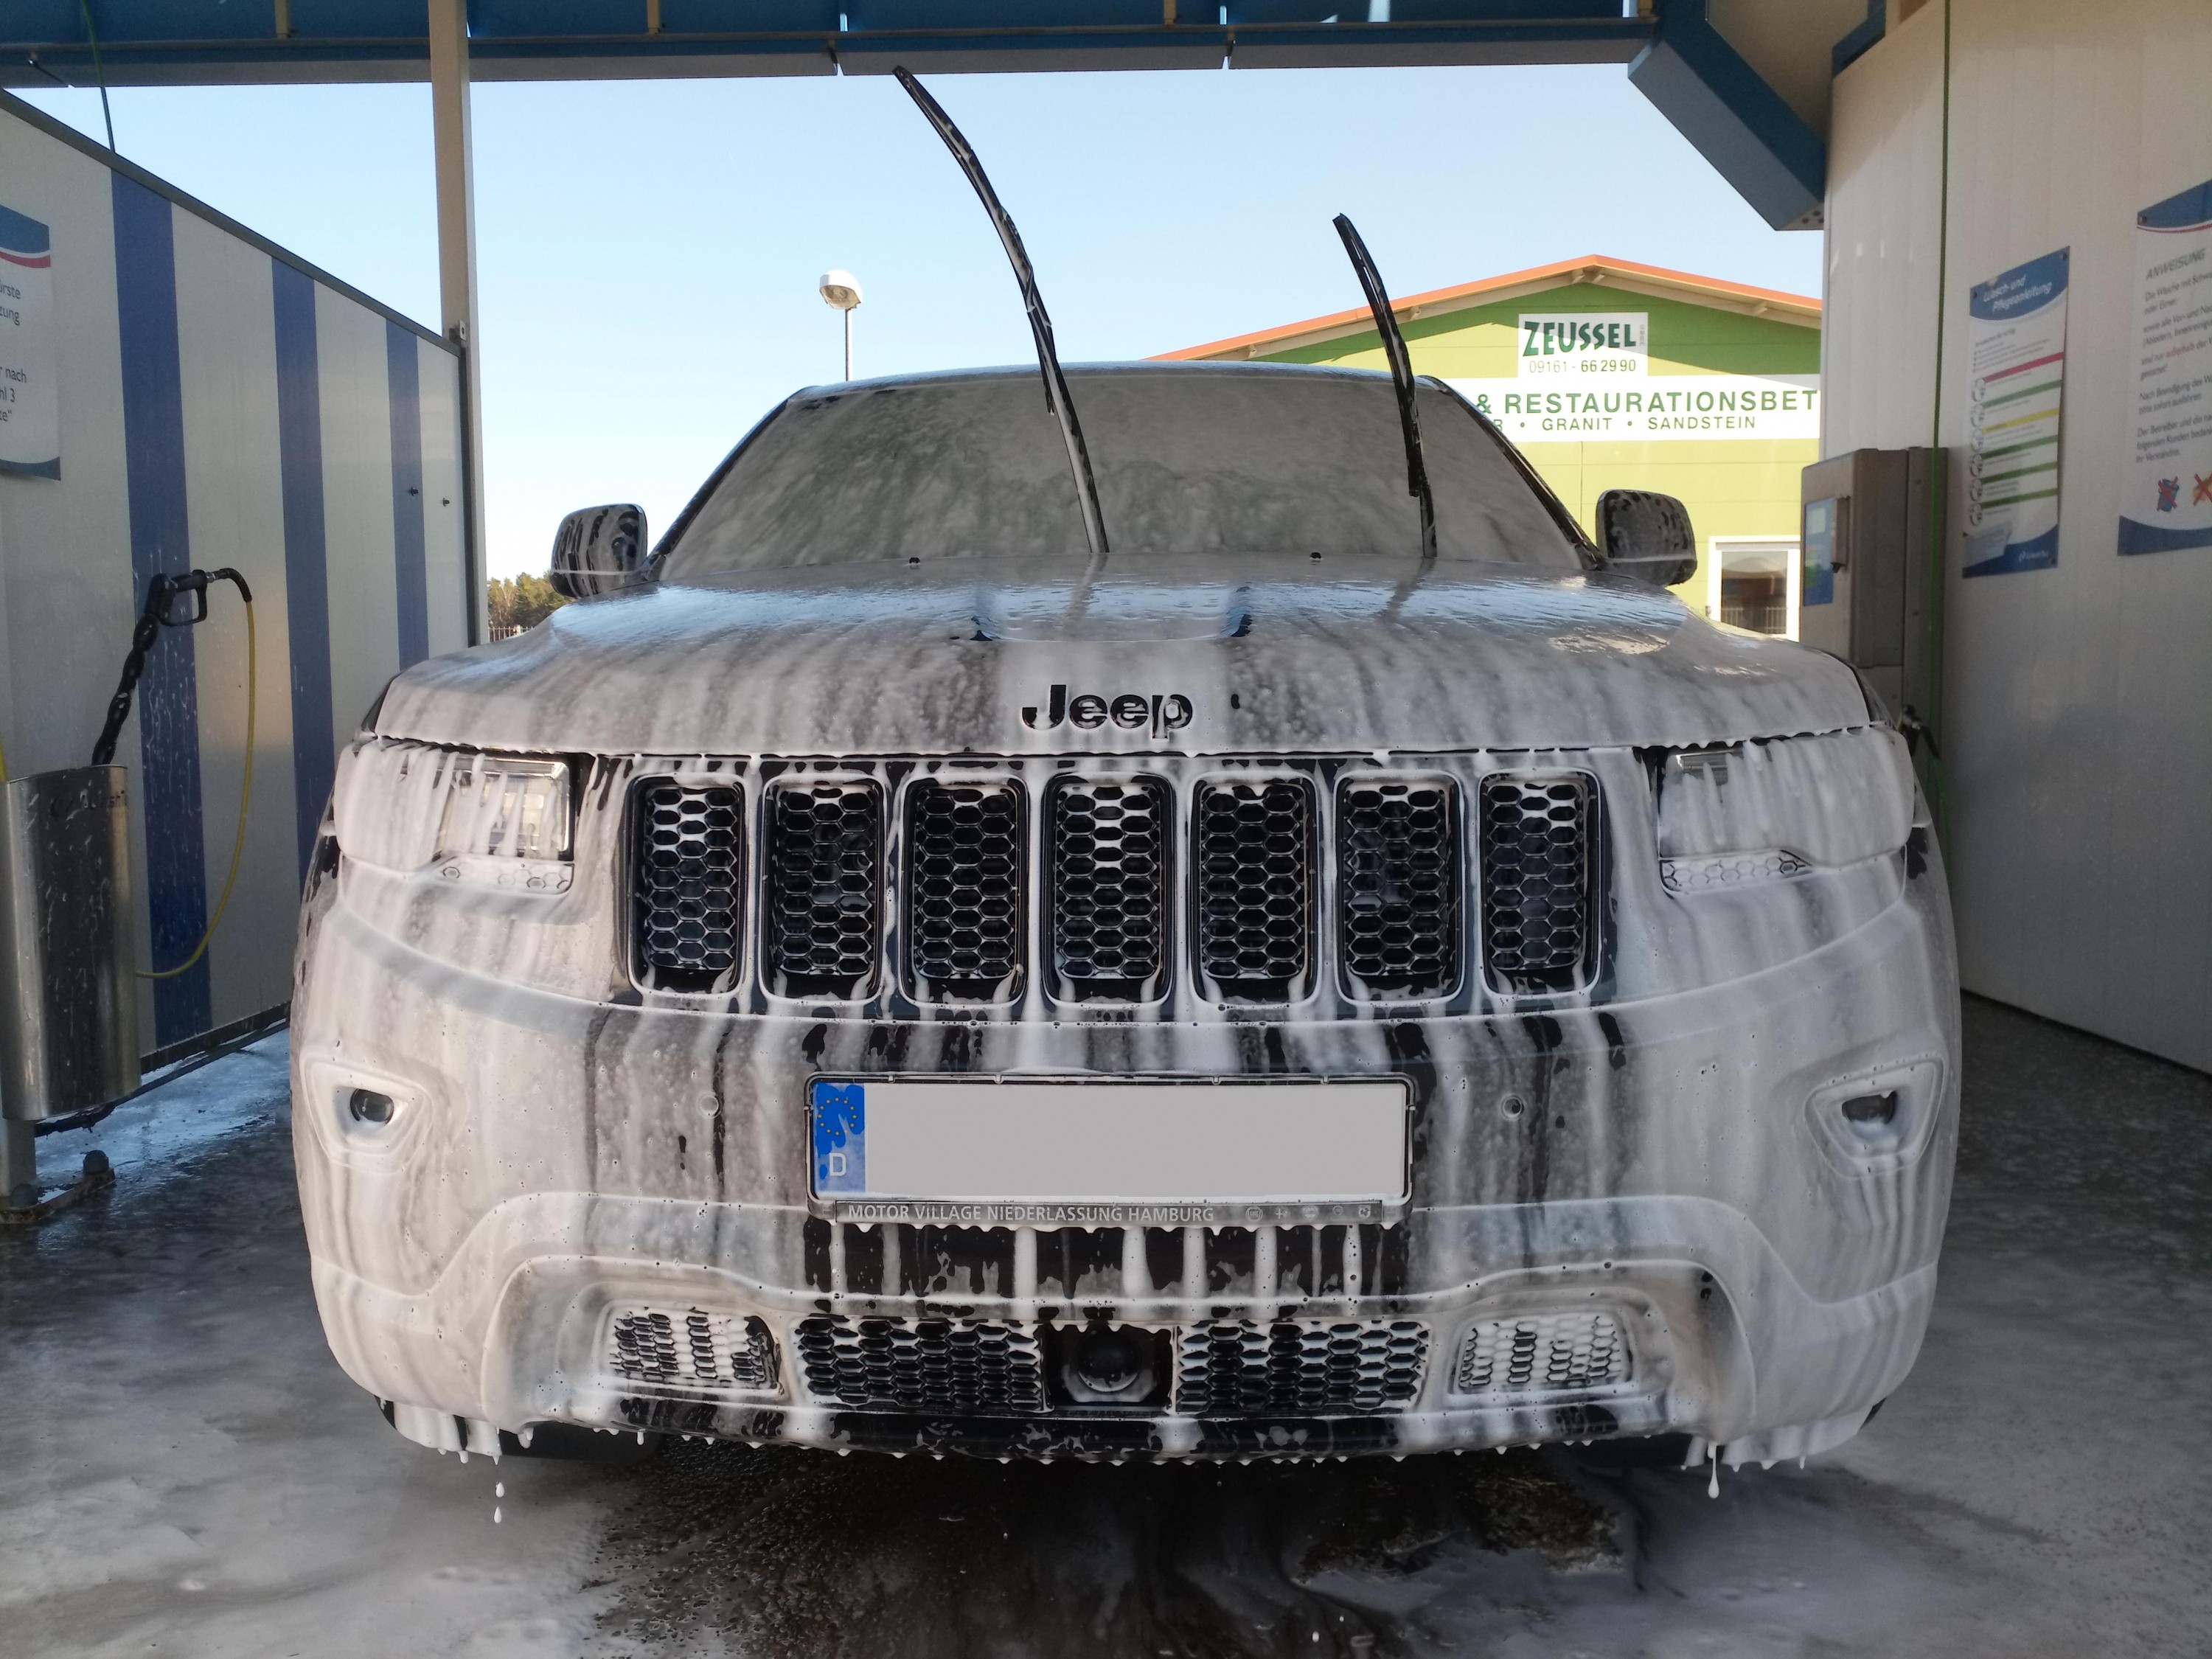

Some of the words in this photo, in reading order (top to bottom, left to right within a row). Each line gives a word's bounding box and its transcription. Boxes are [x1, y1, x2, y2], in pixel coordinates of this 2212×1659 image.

[2146, 248, 2207, 280] ANWEISUNG
[1523, 321, 1636, 357] ZEUSSEL
[5, 368, 27, 383] nach
[1529, 360, 1567, 372] 09161
[10, 388, 15, 403] 3
[1476, 394, 1492, 414] &
[1505, 390, 1818, 414] RESTAURATIONSBET
[1542, 418, 1613, 431] GRANIT
[1648, 416, 1756, 430] SANDSTEIN
[1022, 684, 1193, 739] Jeep
[830, 1152, 846, 1176] D
[848, 1205, 909, 1220] MOTOR
[915, 1206, 981, 1221] VILLAGE
[987, 1206, 1122, 1222] NIEDERLASSUNG
[1128, 1207, 1214, 1222] HAMBURG
